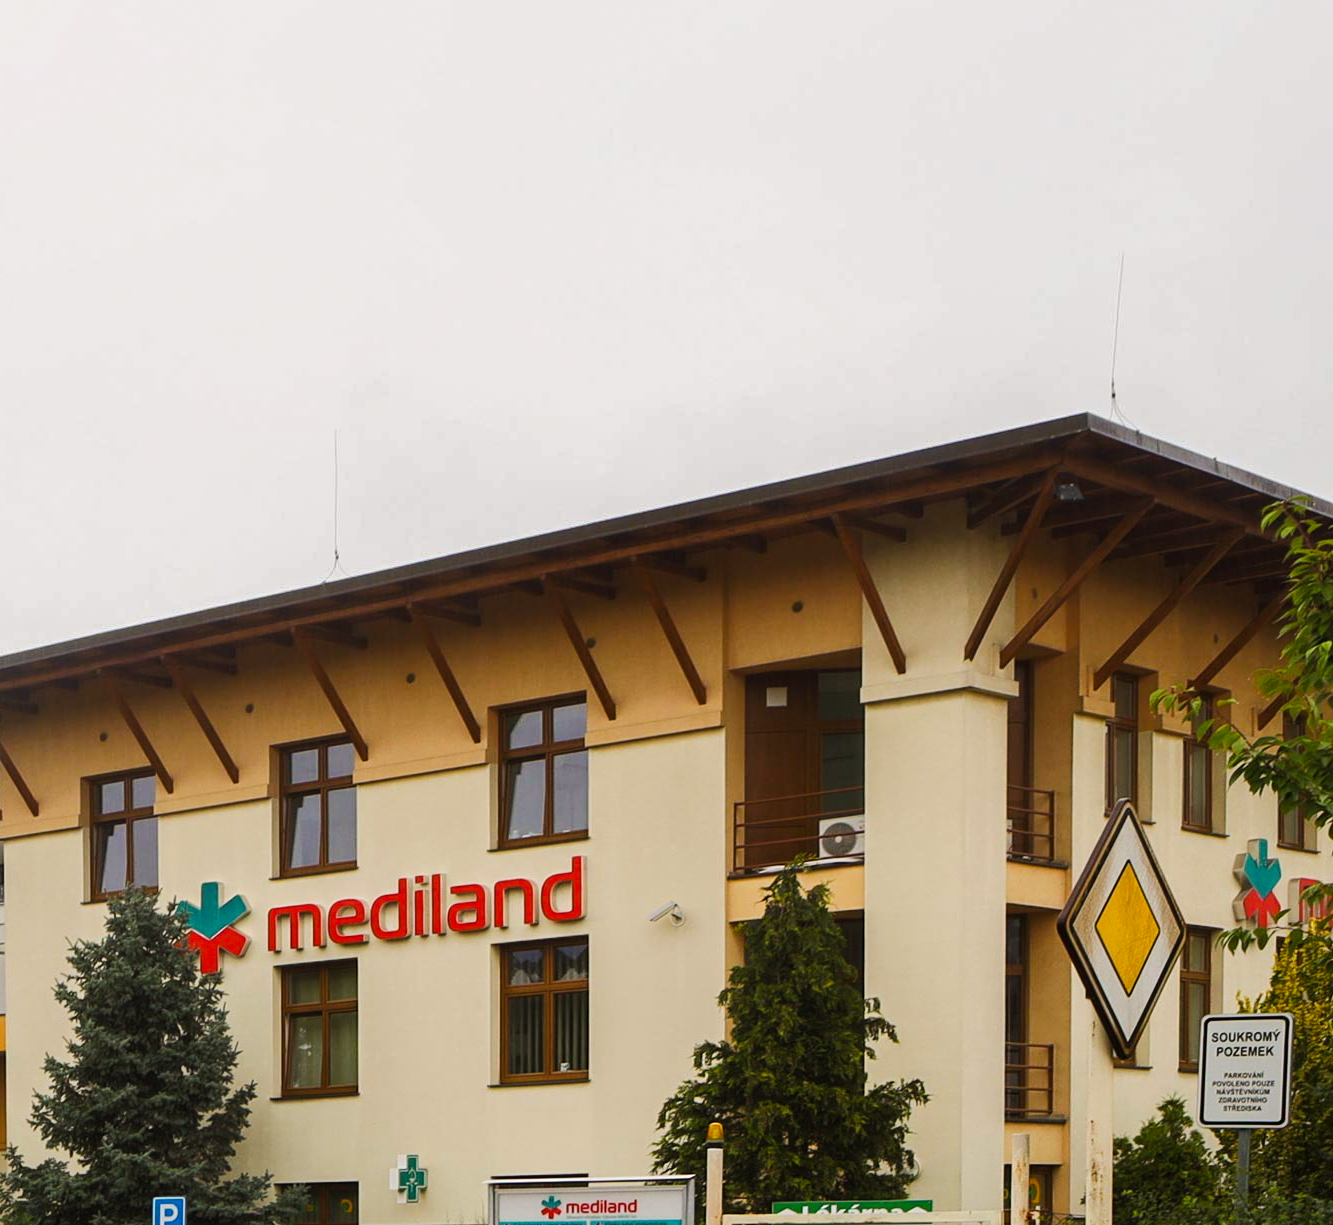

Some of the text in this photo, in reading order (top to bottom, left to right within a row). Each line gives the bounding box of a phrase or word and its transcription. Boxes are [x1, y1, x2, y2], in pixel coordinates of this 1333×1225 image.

[267, 855, 587, 953] mediland
[1211, 1028, 1281, 1043] SOUKROMÝ
[1216, 1045, 1275, 1057] POZEMEK
[1223, 1070, 1265, 1079] PARKOVÁNÍ
[1218, 1096, 1268, 1104] ZDRAVOTNÍHO
[1223, 1104, 1262, 1112] STŘEDISKA
[566, 1199, 637, 1214] mediland
